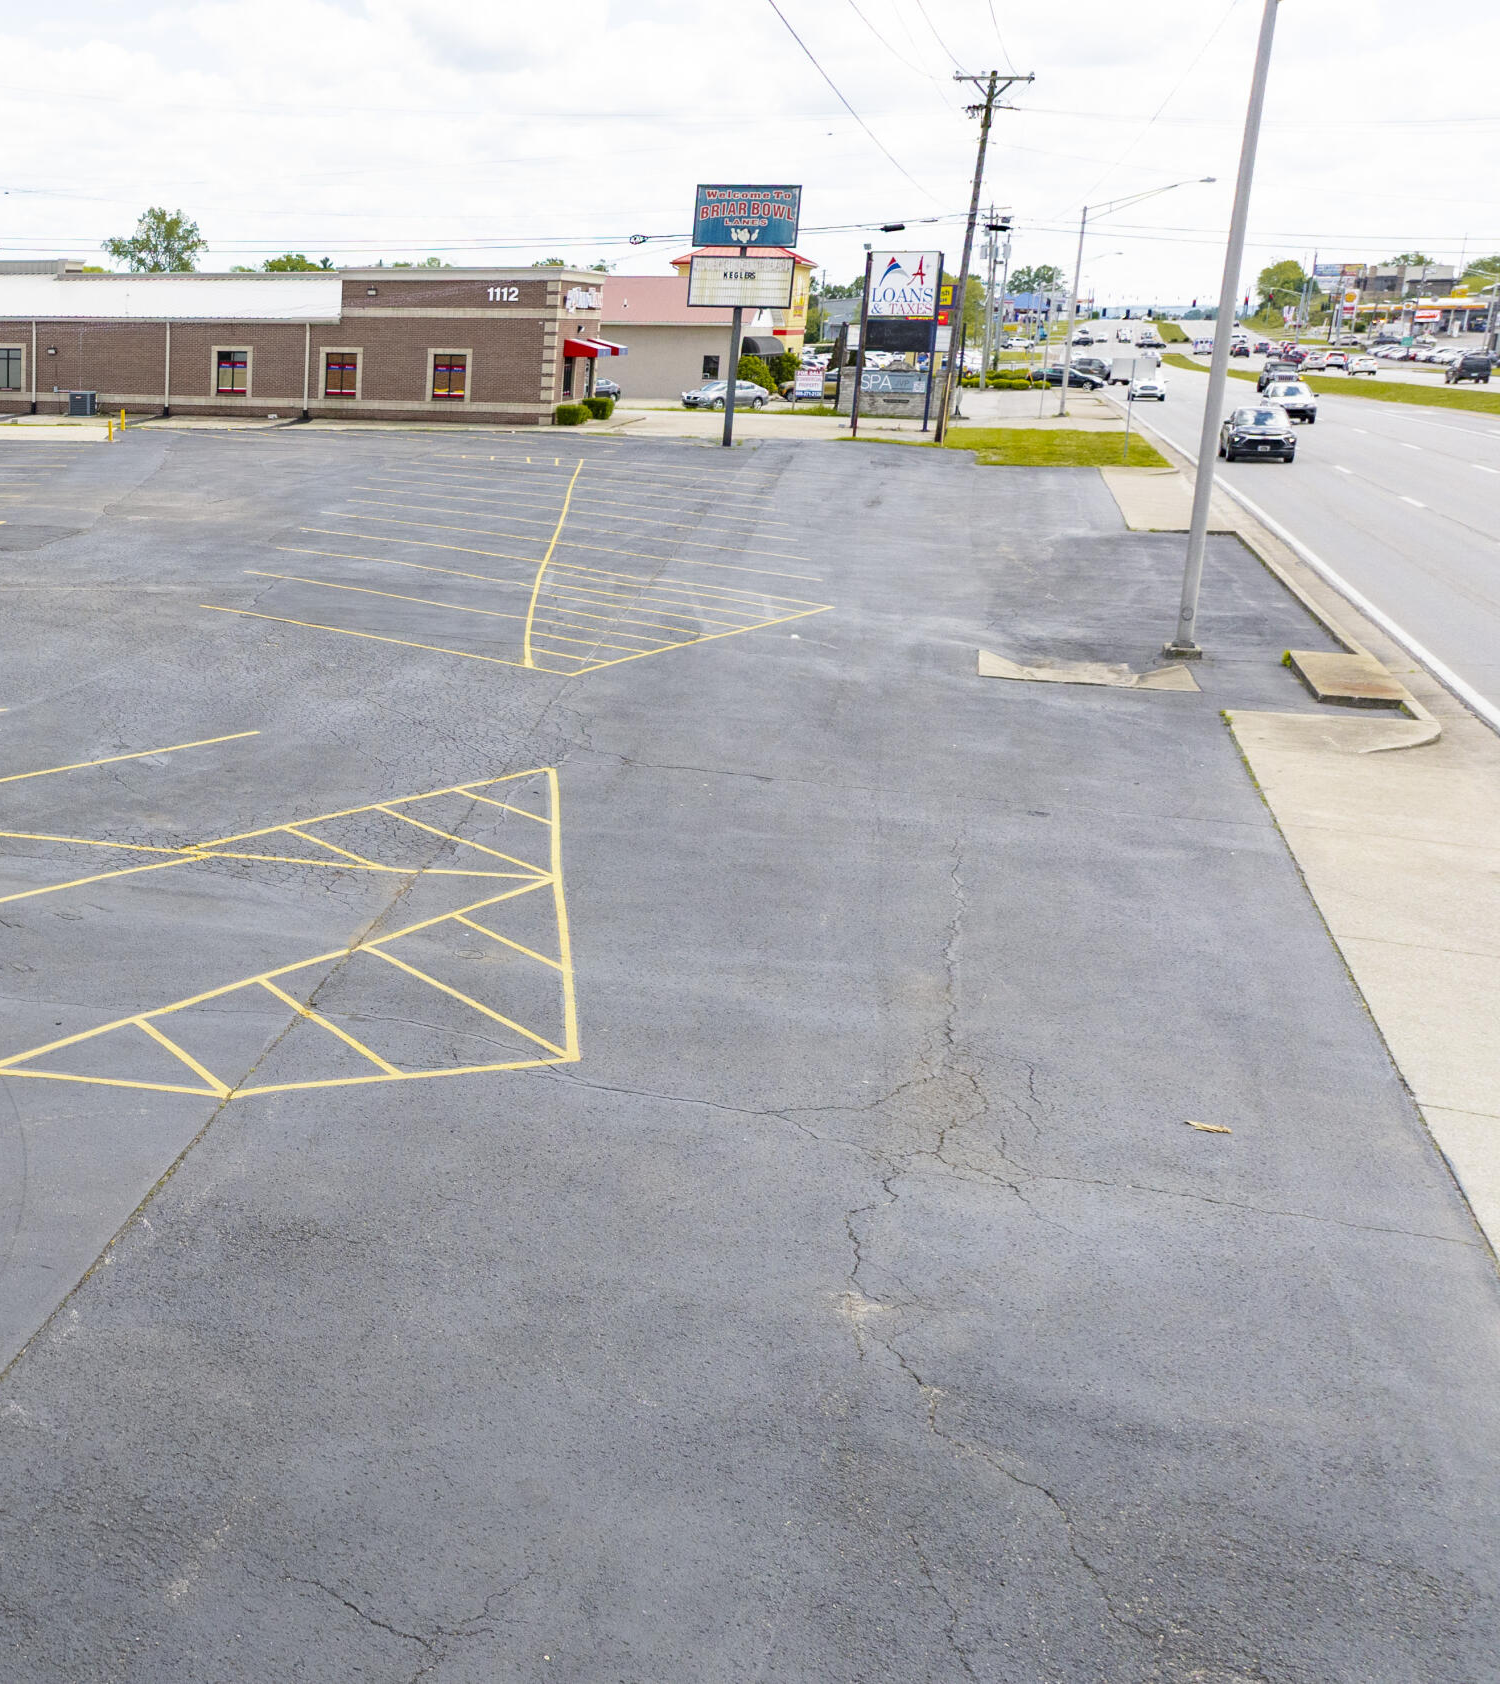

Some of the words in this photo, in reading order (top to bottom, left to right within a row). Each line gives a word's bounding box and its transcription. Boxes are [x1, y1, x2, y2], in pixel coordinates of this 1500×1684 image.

[706, 190, 771, 200] Welcome
[773, 191, 792, 200] To
[700, 202, 747, 220] BRIAR
[750, 202, 795, 221] BOWL
[724, 218, 768, 226] LANES
[487, 287, 519, 302] 1112
[872, 287, 934, 303] LOANS
[871, 303, 883, 315] &
[889, 303, 933, 315] TAXES
[860, 374, 892, 390] SPA
